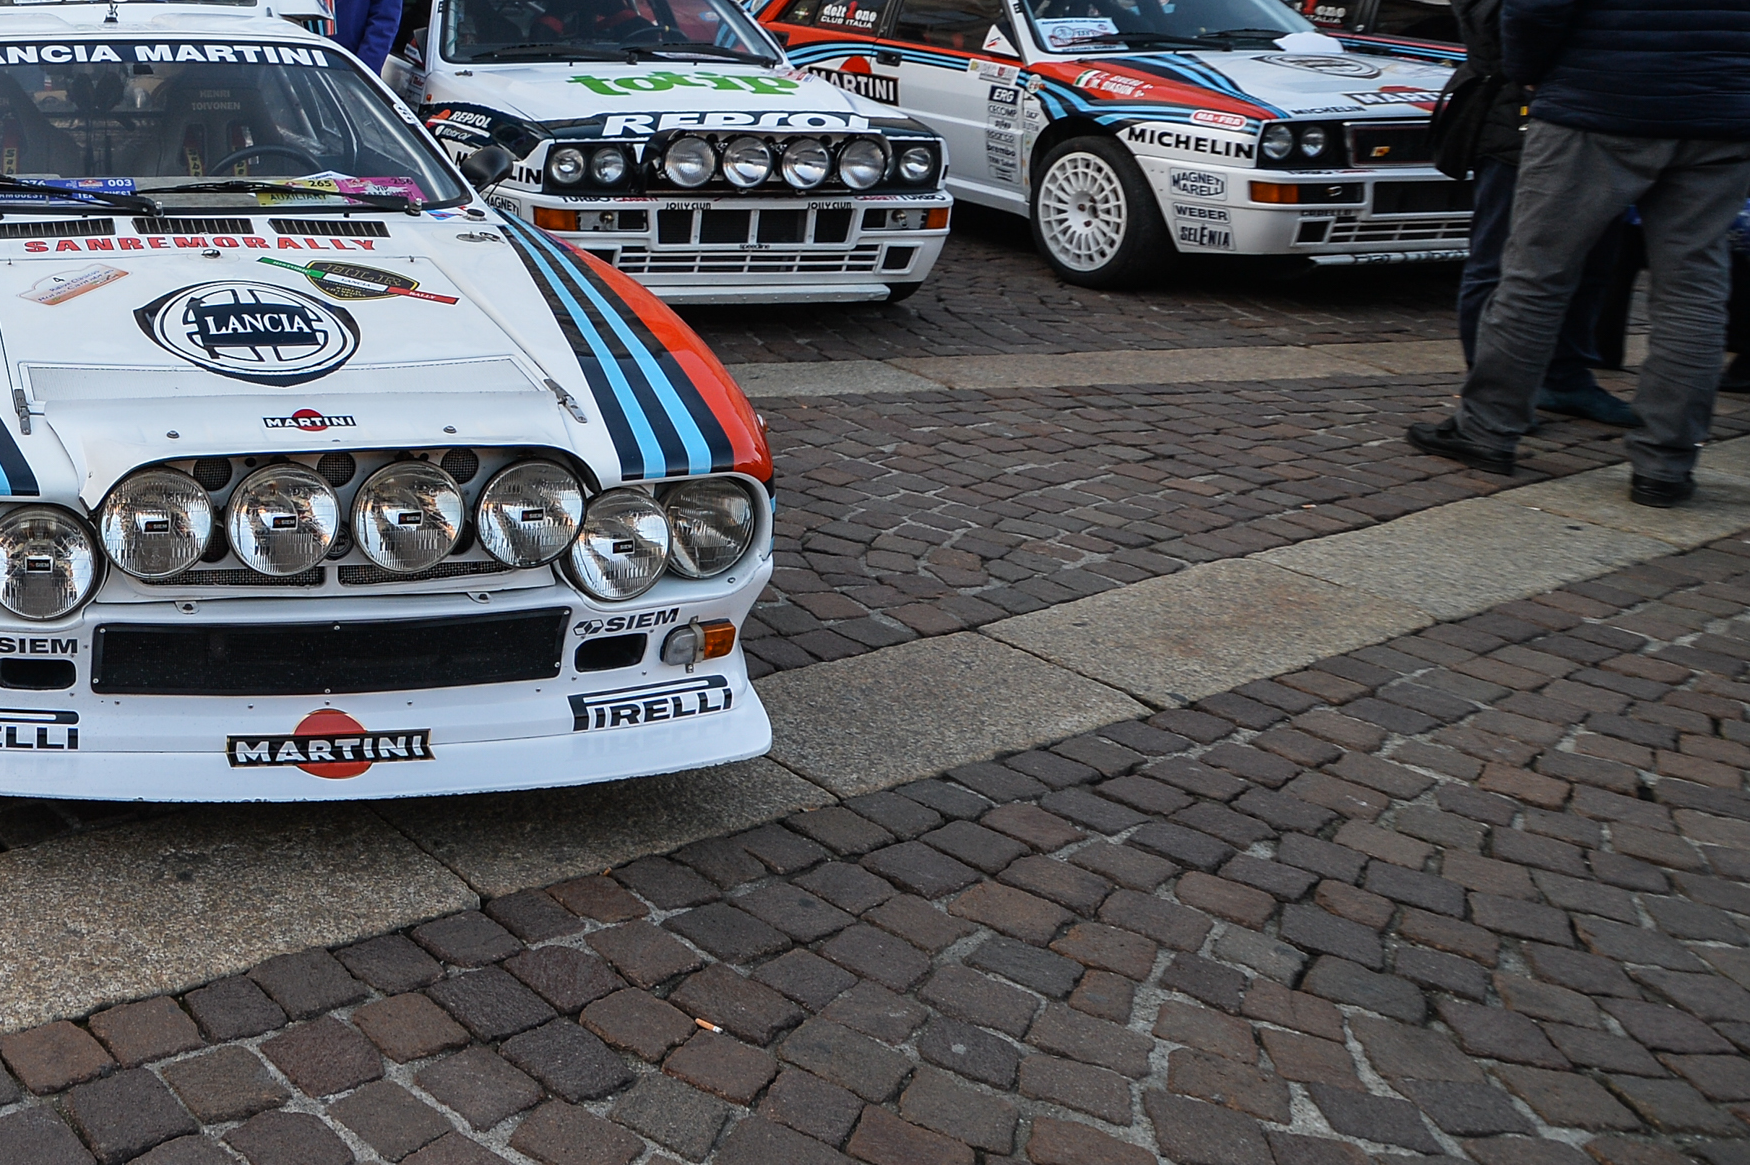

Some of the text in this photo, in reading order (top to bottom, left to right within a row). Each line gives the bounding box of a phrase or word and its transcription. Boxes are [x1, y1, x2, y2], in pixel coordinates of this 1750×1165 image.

[821, 15, 873, 29] CLUB ITALIA
[855, 9, 878, 22] one
[134, 44, 329, 67] MARTINI
[566, 71, 800, 96] totip
[199, 90, 231, 99] HENRI
[993, 88, 1015, 102] ERG
[191, 101, 241, 111] TOIVONEN
[1291, 105, 1366, 116] MICHELIN
[449, 111, 493, 129] REPSOL
[602, 112, 869, 137] REPSOL
[1196, 112, 1242, 125] MA-FRA
[1128, 127, 1255, 160] MICHELIN
[108, 179, 132, 187] 003
[308, 180, 332, 188] 265
[1172, 172, 1224, 189] MAGNETI
[270, 193, 326, 202] AUXILIARY
[665, 201, 690, 211] JOLLY
[807, 201, 831, 210] JOLLY
[1176, 205, 1228, 222] WEBER
[273, 260, 311, 274] HISTORIC
[409, 291, 436, 299] RALLY
[204, 311, 316, 335] LANCIA
[265, 417, 354, 427] MARTINI
[406, 514, 420, 522] SIEM
[529, 511, 543, 519] SIEM
[620, 543, 633, 551] SIEM
[36, 561, 51, 569] SIEM
[604, 609, 679, 633] SIEM
[567, 675, 733, 732] PIRELLI
[235, 735, 424, 767] MARTINI
